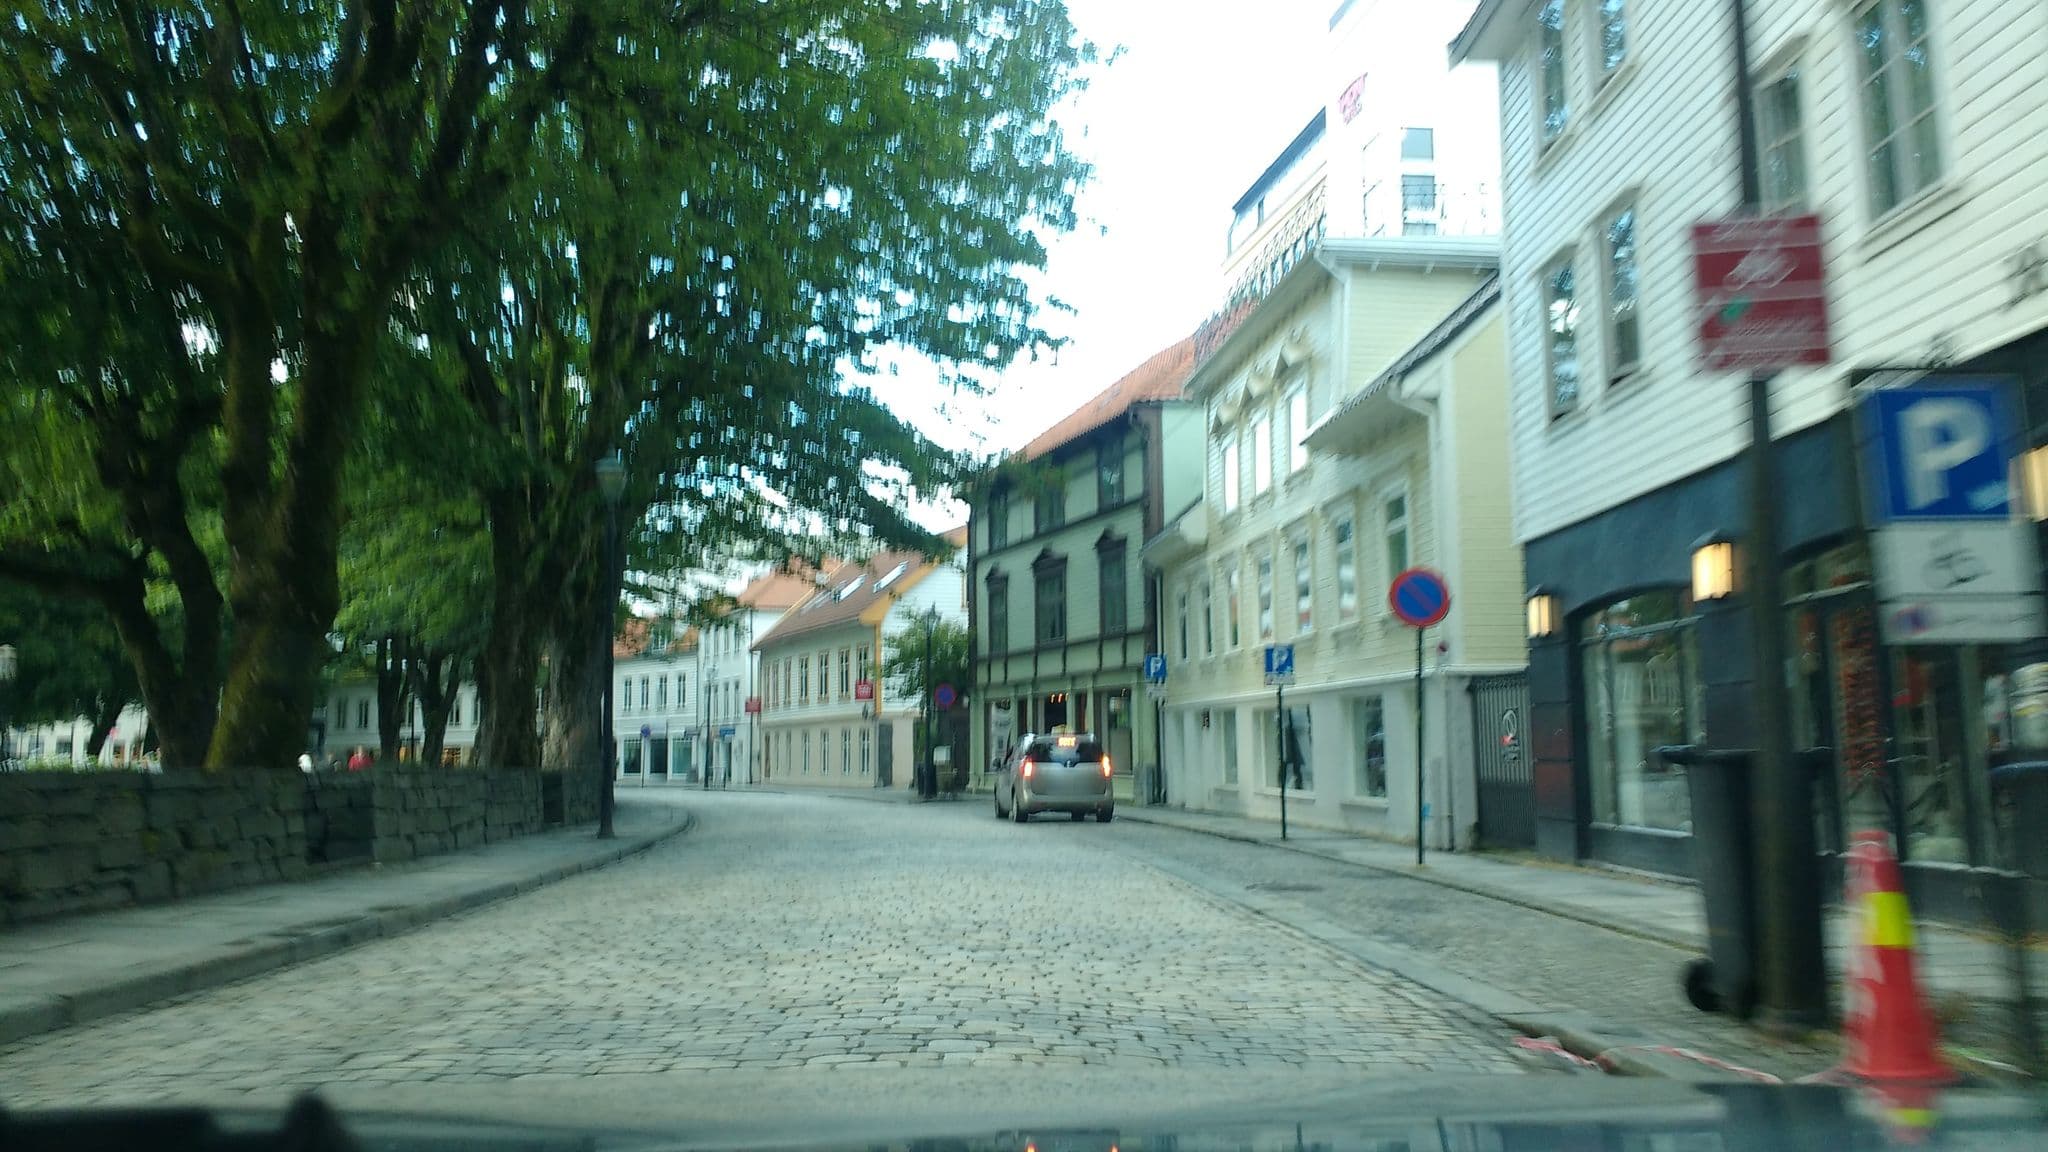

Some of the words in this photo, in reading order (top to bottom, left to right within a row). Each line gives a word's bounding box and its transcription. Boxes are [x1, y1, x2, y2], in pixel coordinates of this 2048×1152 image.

[1896, 397, 1991, 511] P
[1150, 656, 1163, 677] P
[1272, 646, 1288, 670] P
